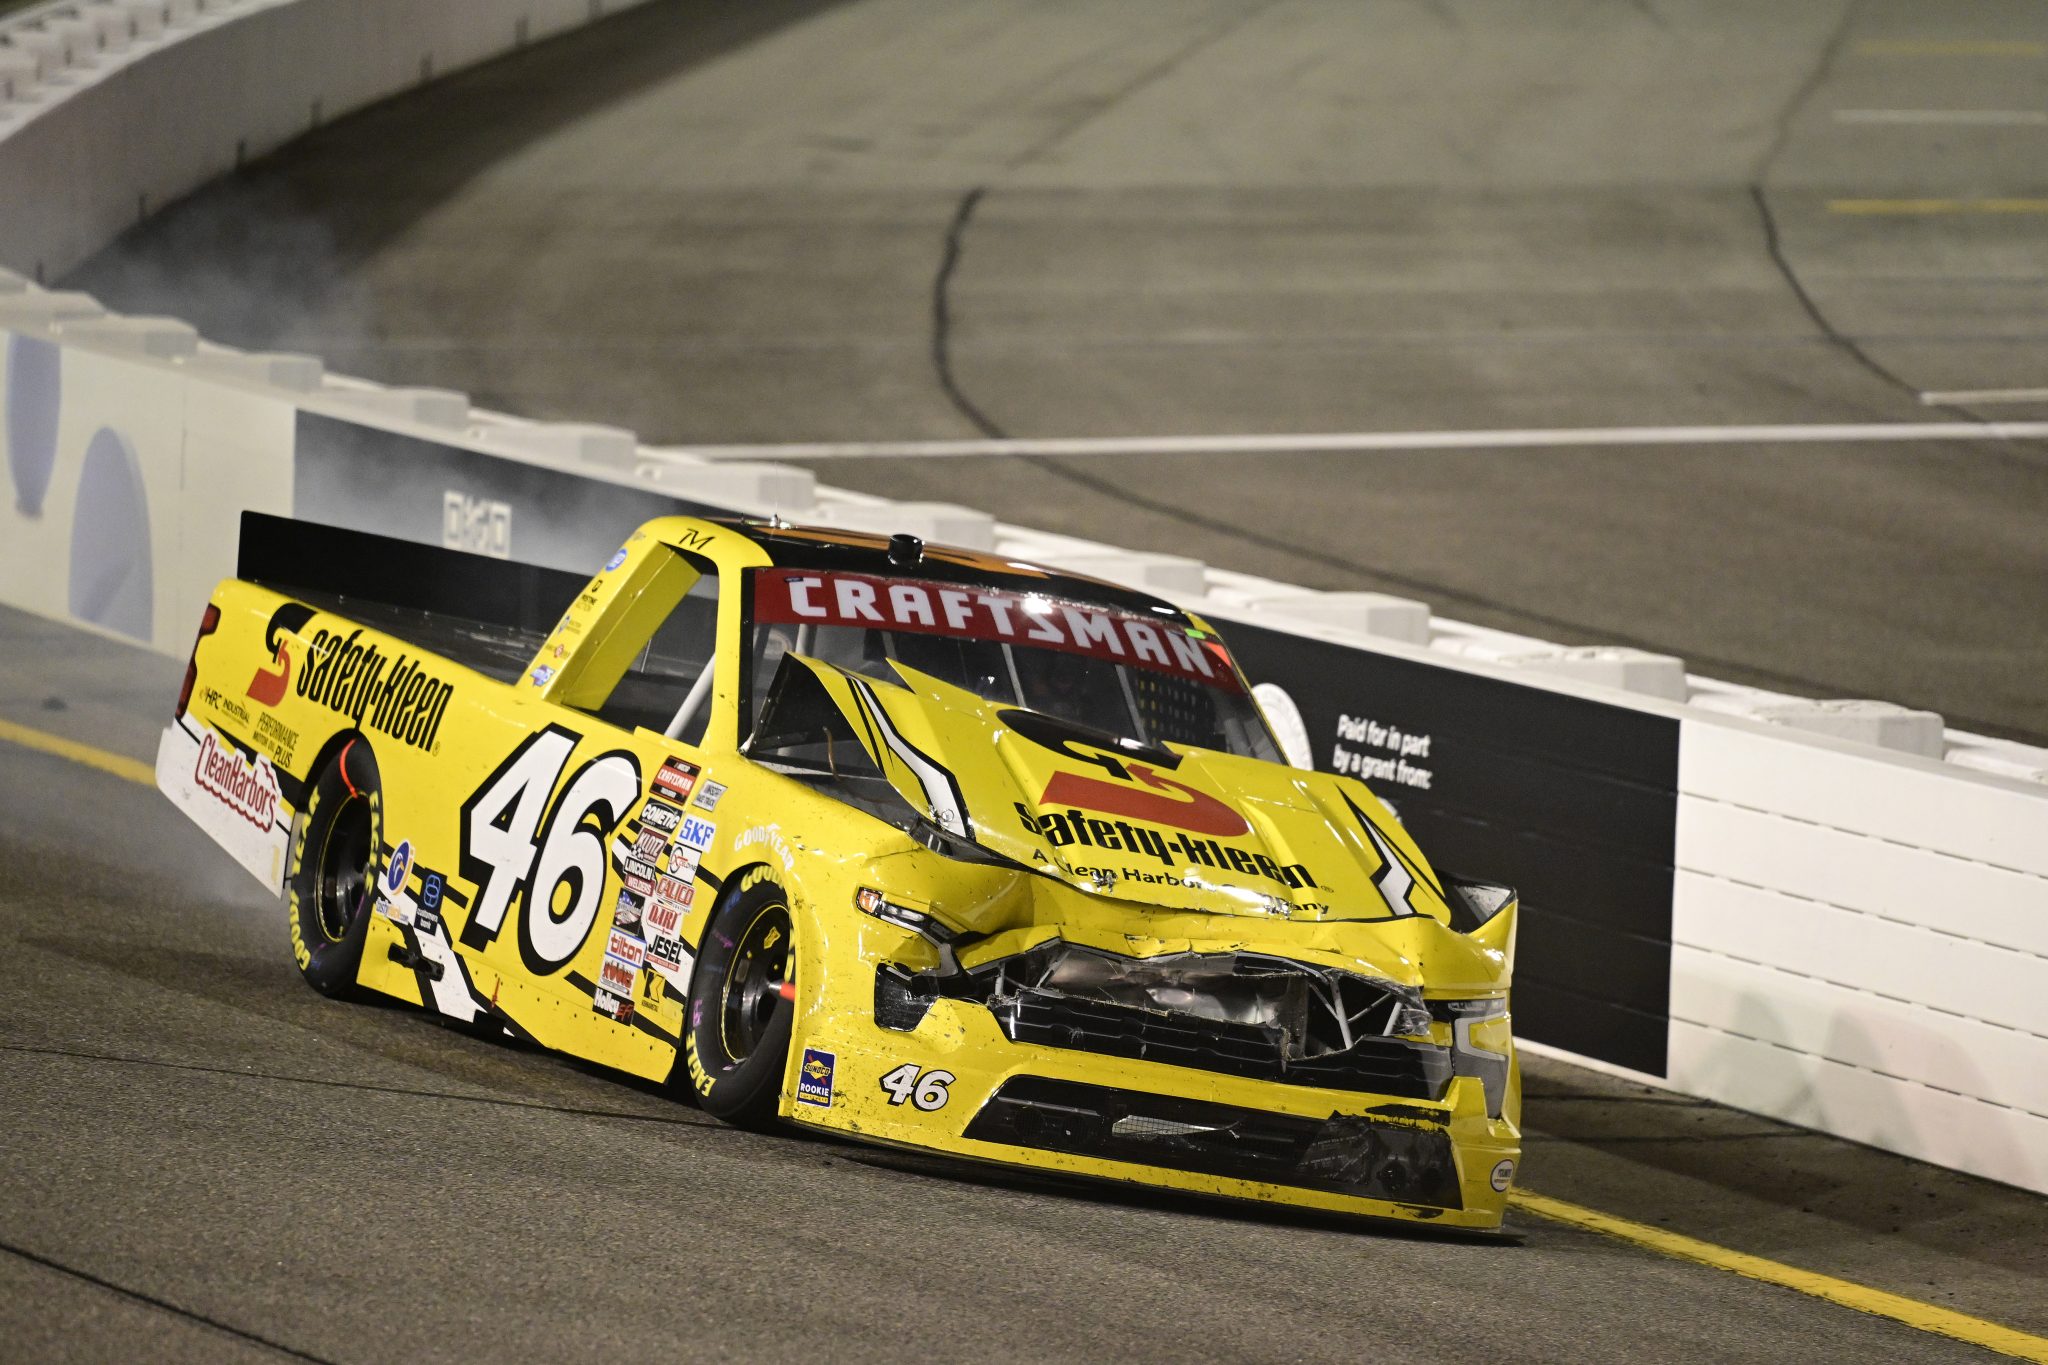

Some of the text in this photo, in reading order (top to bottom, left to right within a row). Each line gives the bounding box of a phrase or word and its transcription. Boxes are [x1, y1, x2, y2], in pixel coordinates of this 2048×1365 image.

[788, 576, 1215, 678] CRAFTSMAN
[296, 628, 454, 753] safety-kleen
[257, 711, 300, 752] PERFORMANCE
[1337, 713, 1431, 758] Paid for in part
[272, 744, 293, 769] PLUS
[1333, 743, 1433, 790] by a grant from:
[657, 768, 693, 793] CRAFTSMAN
[641, 803, 681, 830] COMETIC
[679, 818, 715, 846] SKF
[459, 722, 642, 976] 46
[638, 831, 665, 858] KLOTZ
[733, 823, 795, 872] GOODYEAR
[1013, 801, 1319, 890] safety-kleen
[1032, 848, 1049, 864] A
[624, 856, 653, 881] LINCOLN
[656, 876, 696, 907] CALICO
[609, 933, 643, 965] tilton
[648, 934, 682, 965] JESEL
[593, 987, 621, 1020] Holley
[685, 1029, 717, 1097] EAGLE
[803, 1062, 832, 1077] SUNOCO
[800, 1082, 830, 1097] ROOKIE
[878, 1063, 957, 1113] 46
